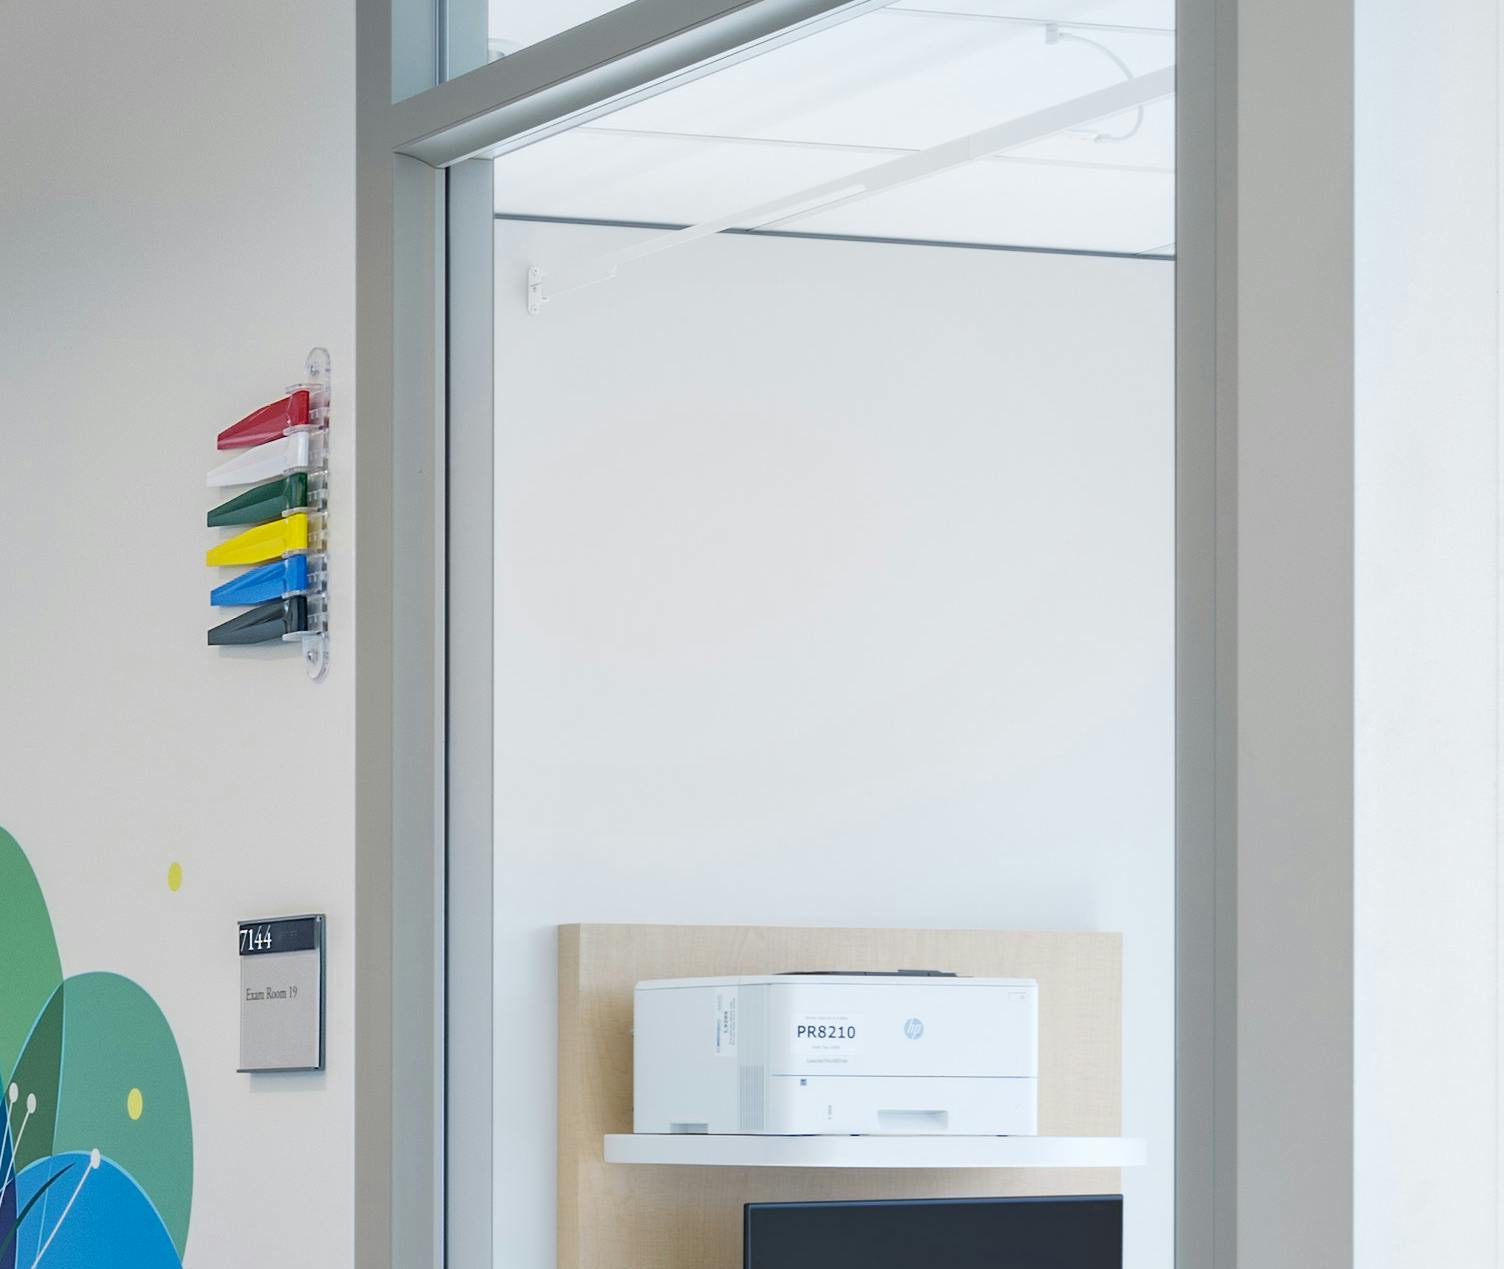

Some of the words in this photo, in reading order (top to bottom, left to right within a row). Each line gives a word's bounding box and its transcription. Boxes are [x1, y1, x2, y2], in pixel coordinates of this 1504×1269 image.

[239, 924, 273, 953] 7144
[246, 988, 265, 1001] Exam
[266, 986, 287, 1000] Room
[289, 985, 298, 999] 19
[796, 1024, 856, 1039] PR8210
